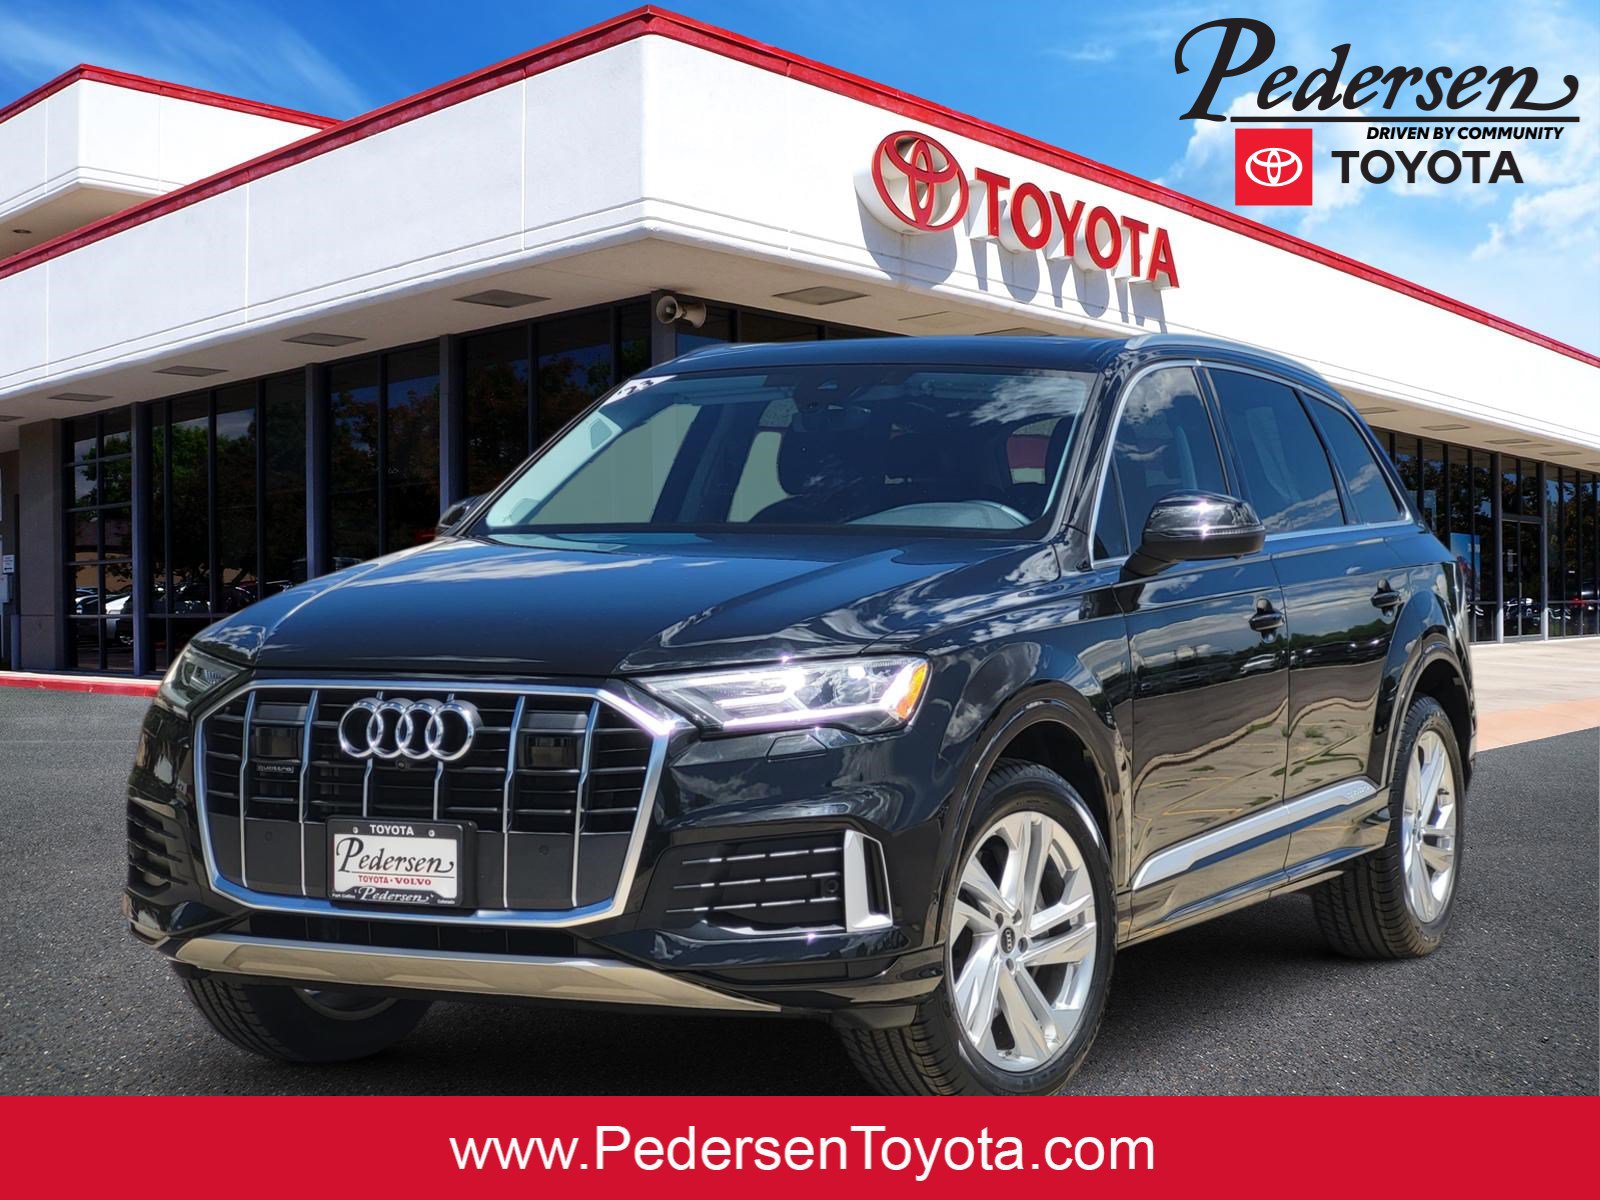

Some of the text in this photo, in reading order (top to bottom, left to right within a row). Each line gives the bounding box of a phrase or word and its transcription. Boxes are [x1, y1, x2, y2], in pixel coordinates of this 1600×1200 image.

[975, 167, 1180, 288] TOYOTA
[370, 824, 415, 836] TOYOTA
[336, 837, 455, 873] Pedersen
[358, 875, 432, 886] TOYOTA VOLVO
[358, 886, 430, 902] Pedersen
